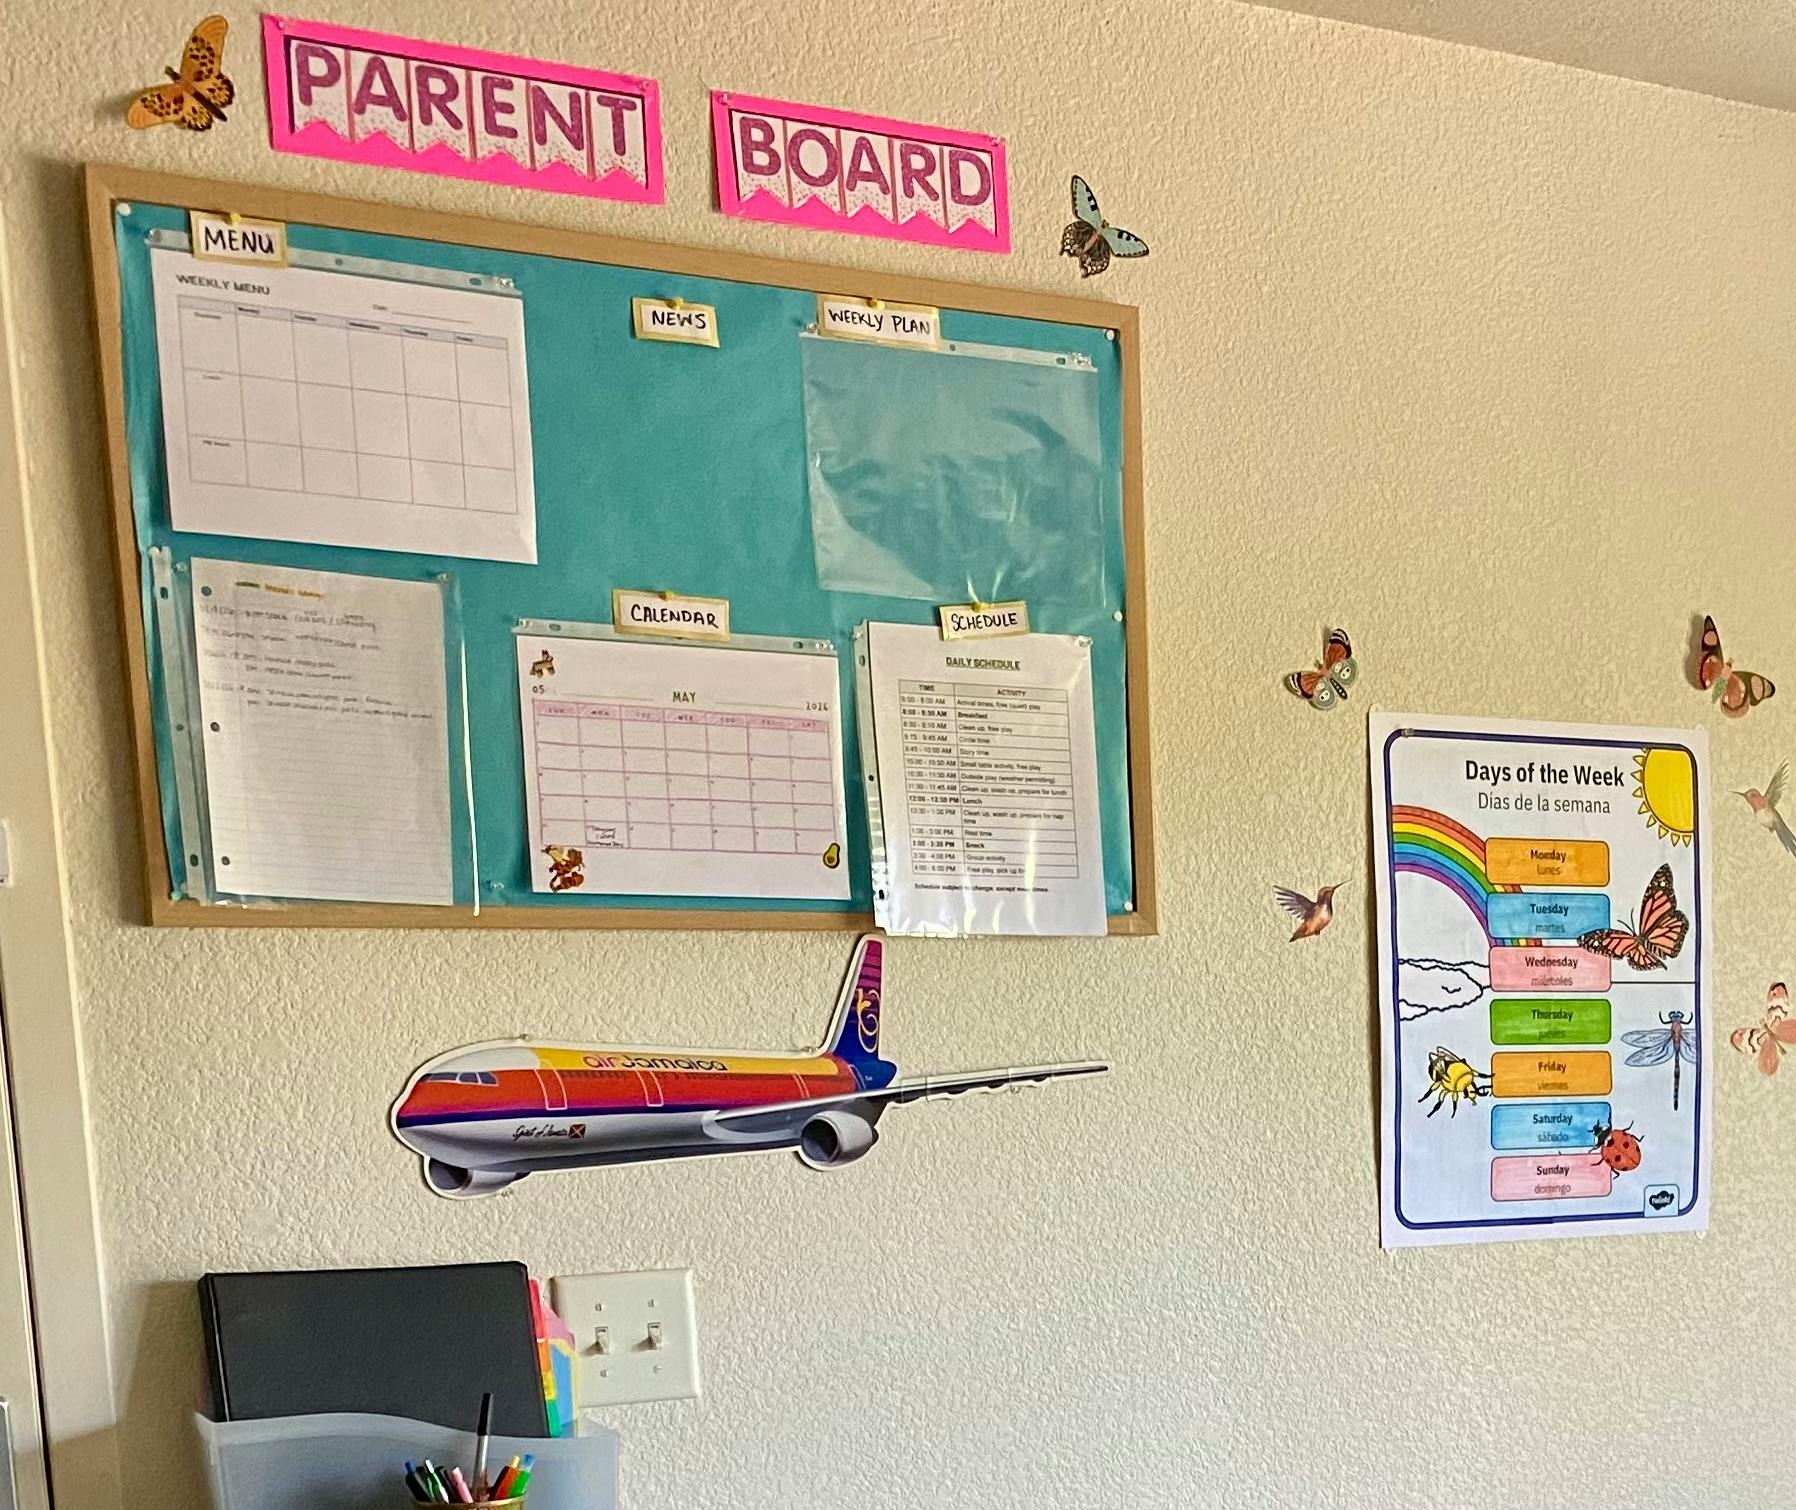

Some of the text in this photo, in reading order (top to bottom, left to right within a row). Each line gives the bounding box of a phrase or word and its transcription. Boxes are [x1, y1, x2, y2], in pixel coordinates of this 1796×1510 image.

[296, 43, 993, 206] PARENT BOARD
[204, 226, 275, 255] MENU
[175, 274, 270, 296] WEEKLY MENU
[652, 310, 707, 329] NEWS
[828, 308, 931, 335] WEEKLY PLAN
[630, 604, 720, 628] CALENDAR
[951, 612, 1018, 631] SCHEDULE
[946, 656, 1020, 670] DAILY SCHEDULE
[673, 691, 696, 703] MAY
[1465, 760, 1625, 787] Days of the Week
[1478, 792, 1610, 814] Días de la semana
[1530, 849, 1566, 863] Monday
[1530, 904, 1569, 917] Tuesday
[1525, 956, 1578, 969] Wednesday
[1531, 1009, 1574, 1022] Thursday
[1538, 1061, 1566, 1074] Friday
[1533, 1113, 1573, 1126] Saturday
[1536, 1164, 1569, 1177] Sunday
[1534, 1182, 1571, 1195] domingo
